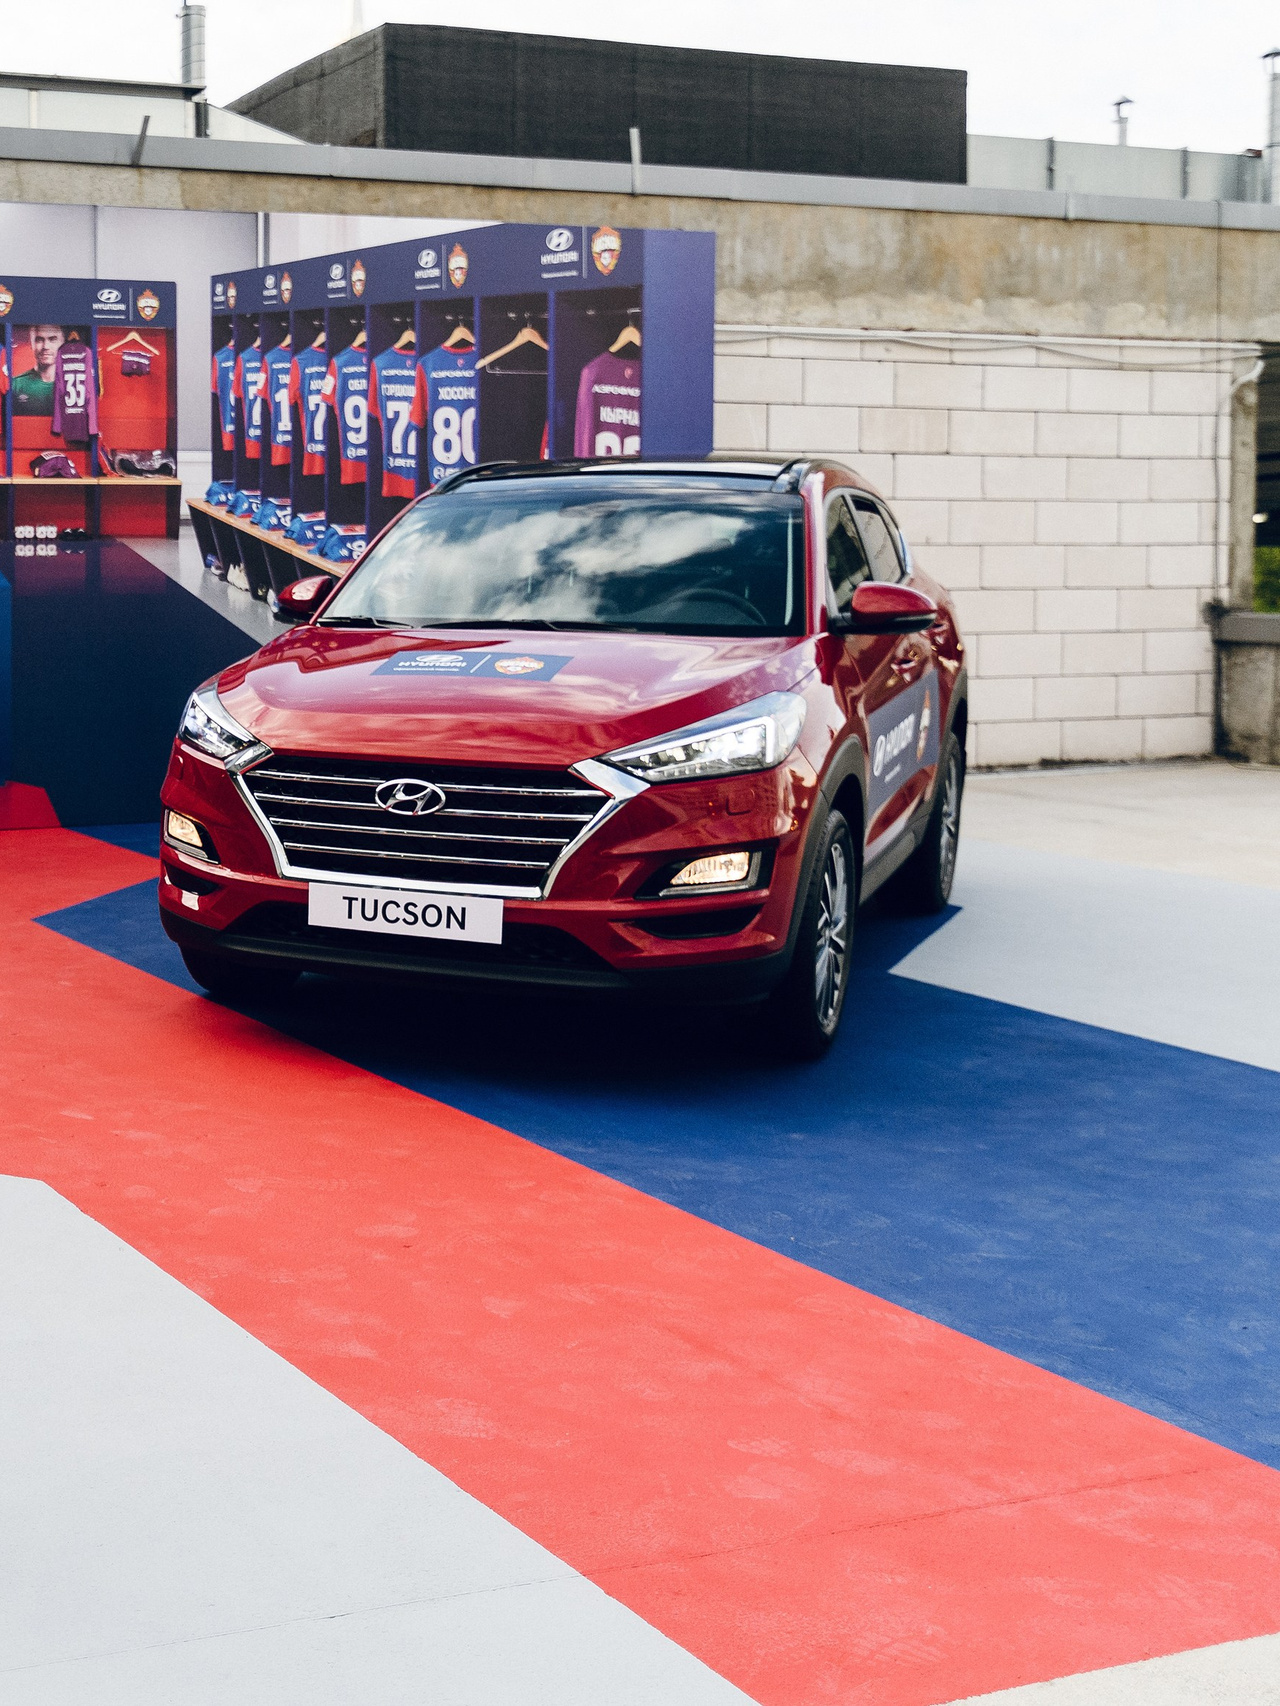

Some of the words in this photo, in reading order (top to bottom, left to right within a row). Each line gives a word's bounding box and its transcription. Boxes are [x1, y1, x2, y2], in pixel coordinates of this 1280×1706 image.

[541, 250, 579, 265] HYUNDAI
[64, 373, 86, 406] 35
[344, 395, 368, 445] 9
[342, 896, 467, 931] TUCSON
